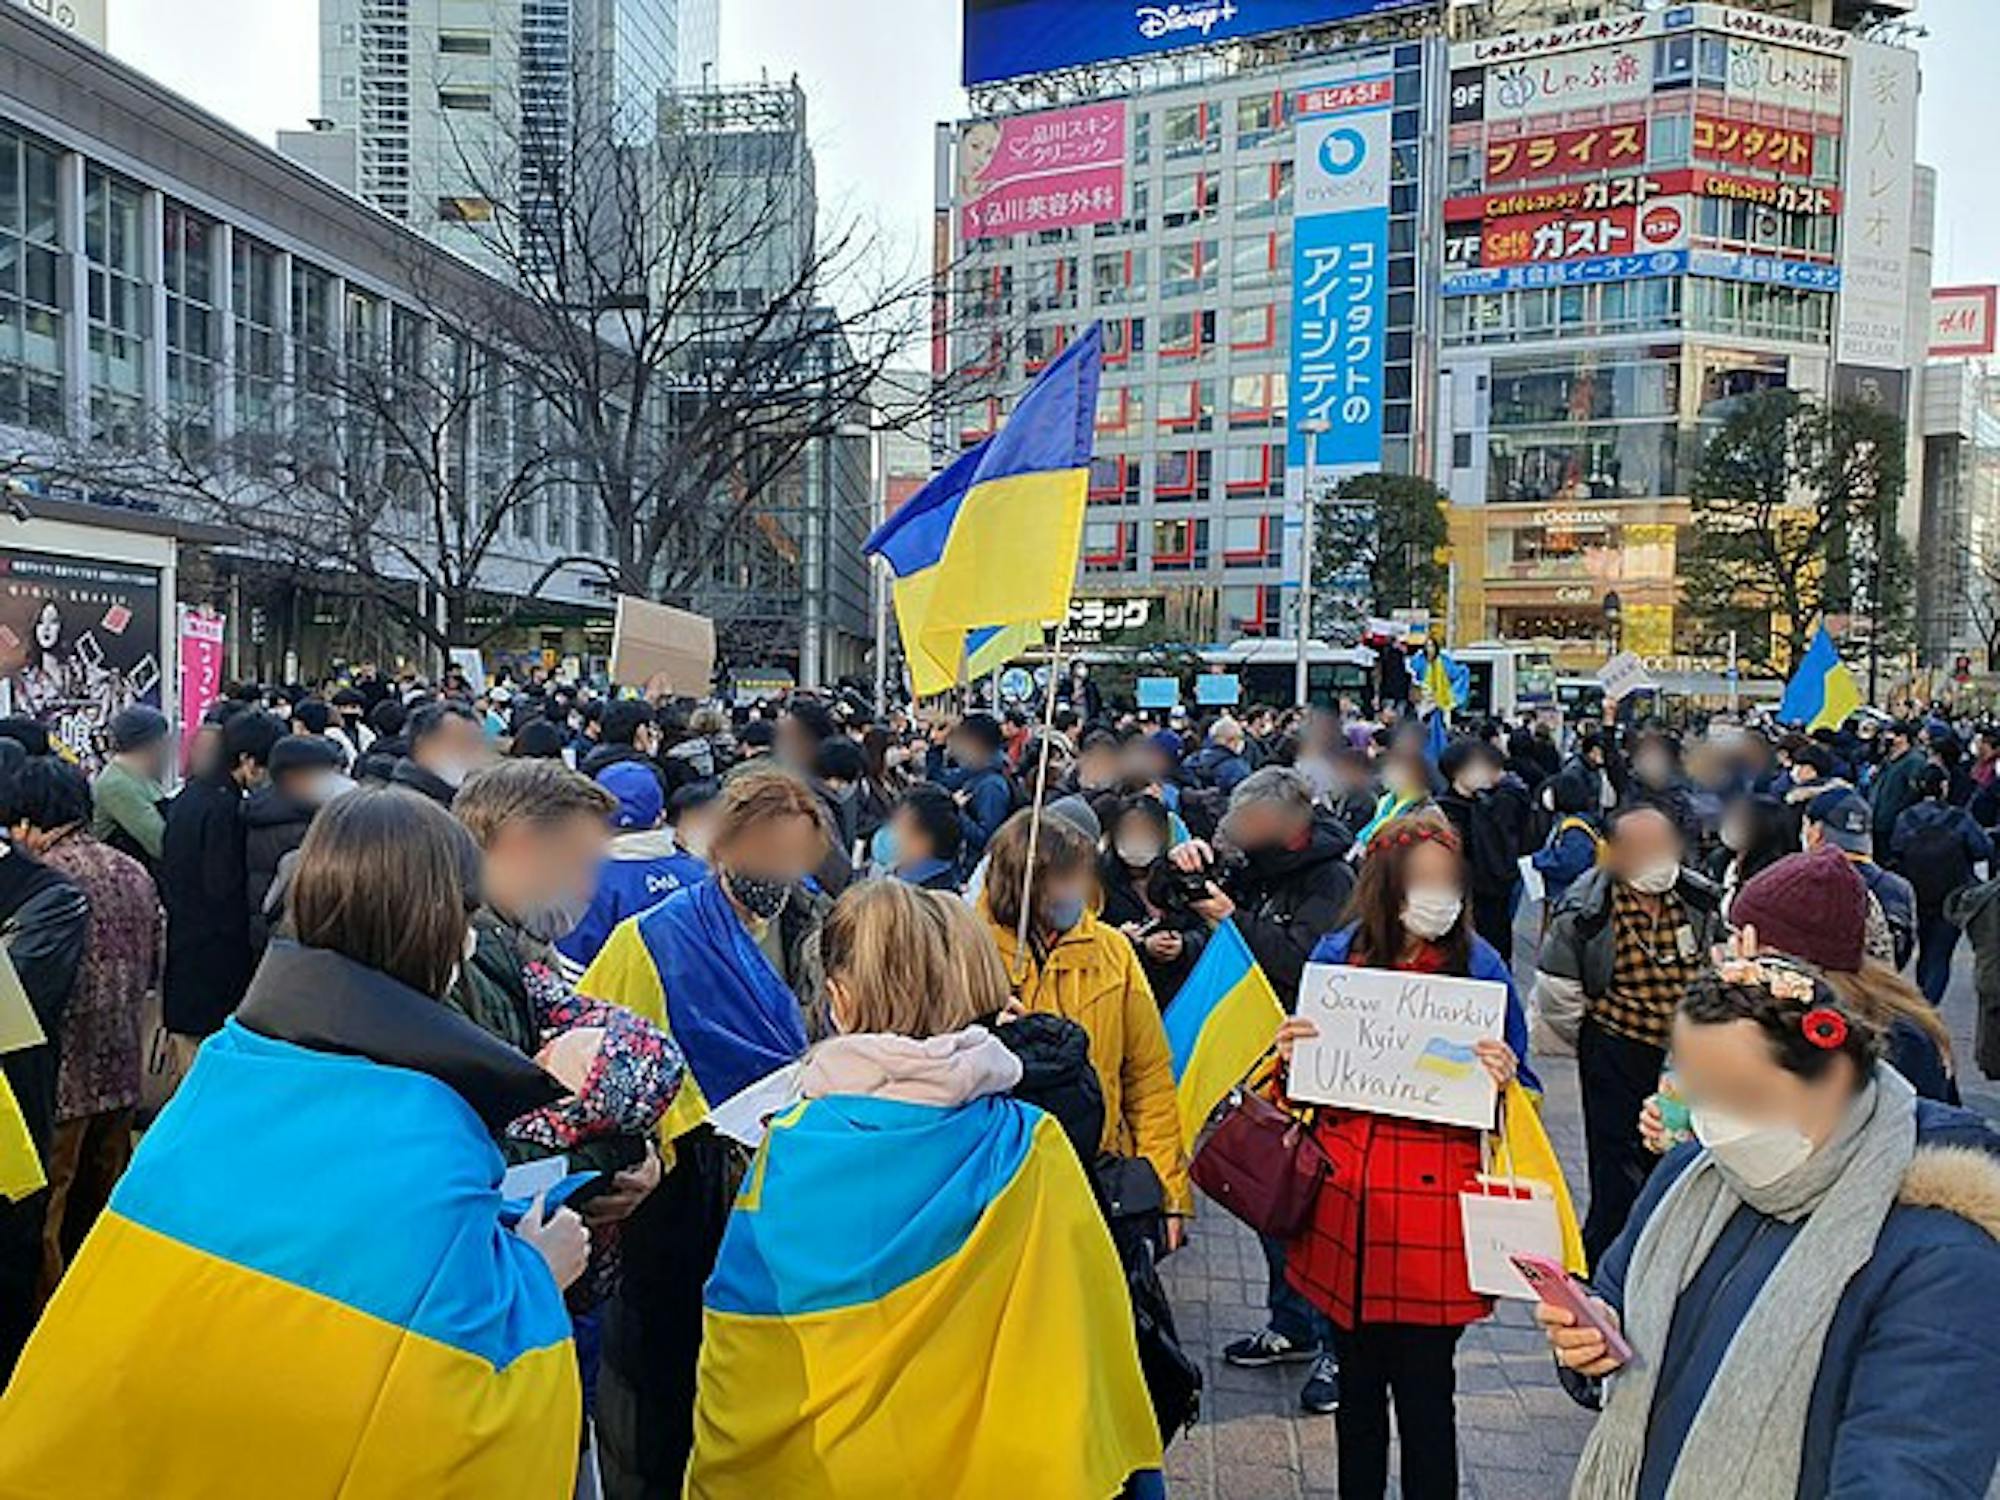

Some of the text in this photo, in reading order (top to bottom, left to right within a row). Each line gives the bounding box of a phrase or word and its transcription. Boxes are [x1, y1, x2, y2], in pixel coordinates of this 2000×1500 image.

[1136, 0, 1238, 38] Disney+
[1452, 83, 1483, 109] 9F
[1031, 114, 1117, 146] 品川スキン
[1694, 119, 1809, 165] コンタクト
[1032, 137, 1109, 167] クリニック
[985, 183, 1115, 226] 品川美容外科
[1446, 235, 1482, 261] 7F
[1531, 216, 1628, 260] ガスト
[1300, 246, 1342, 421] アイシティ
[1342, 242, 1374, 424] コンタクトの
[1321, 974, 1499, 1029] Save Kharkiv
[1358, 1017, 1410, 1060] Kyiv
[1315, 1046, 1442, 1105] Ukraine
